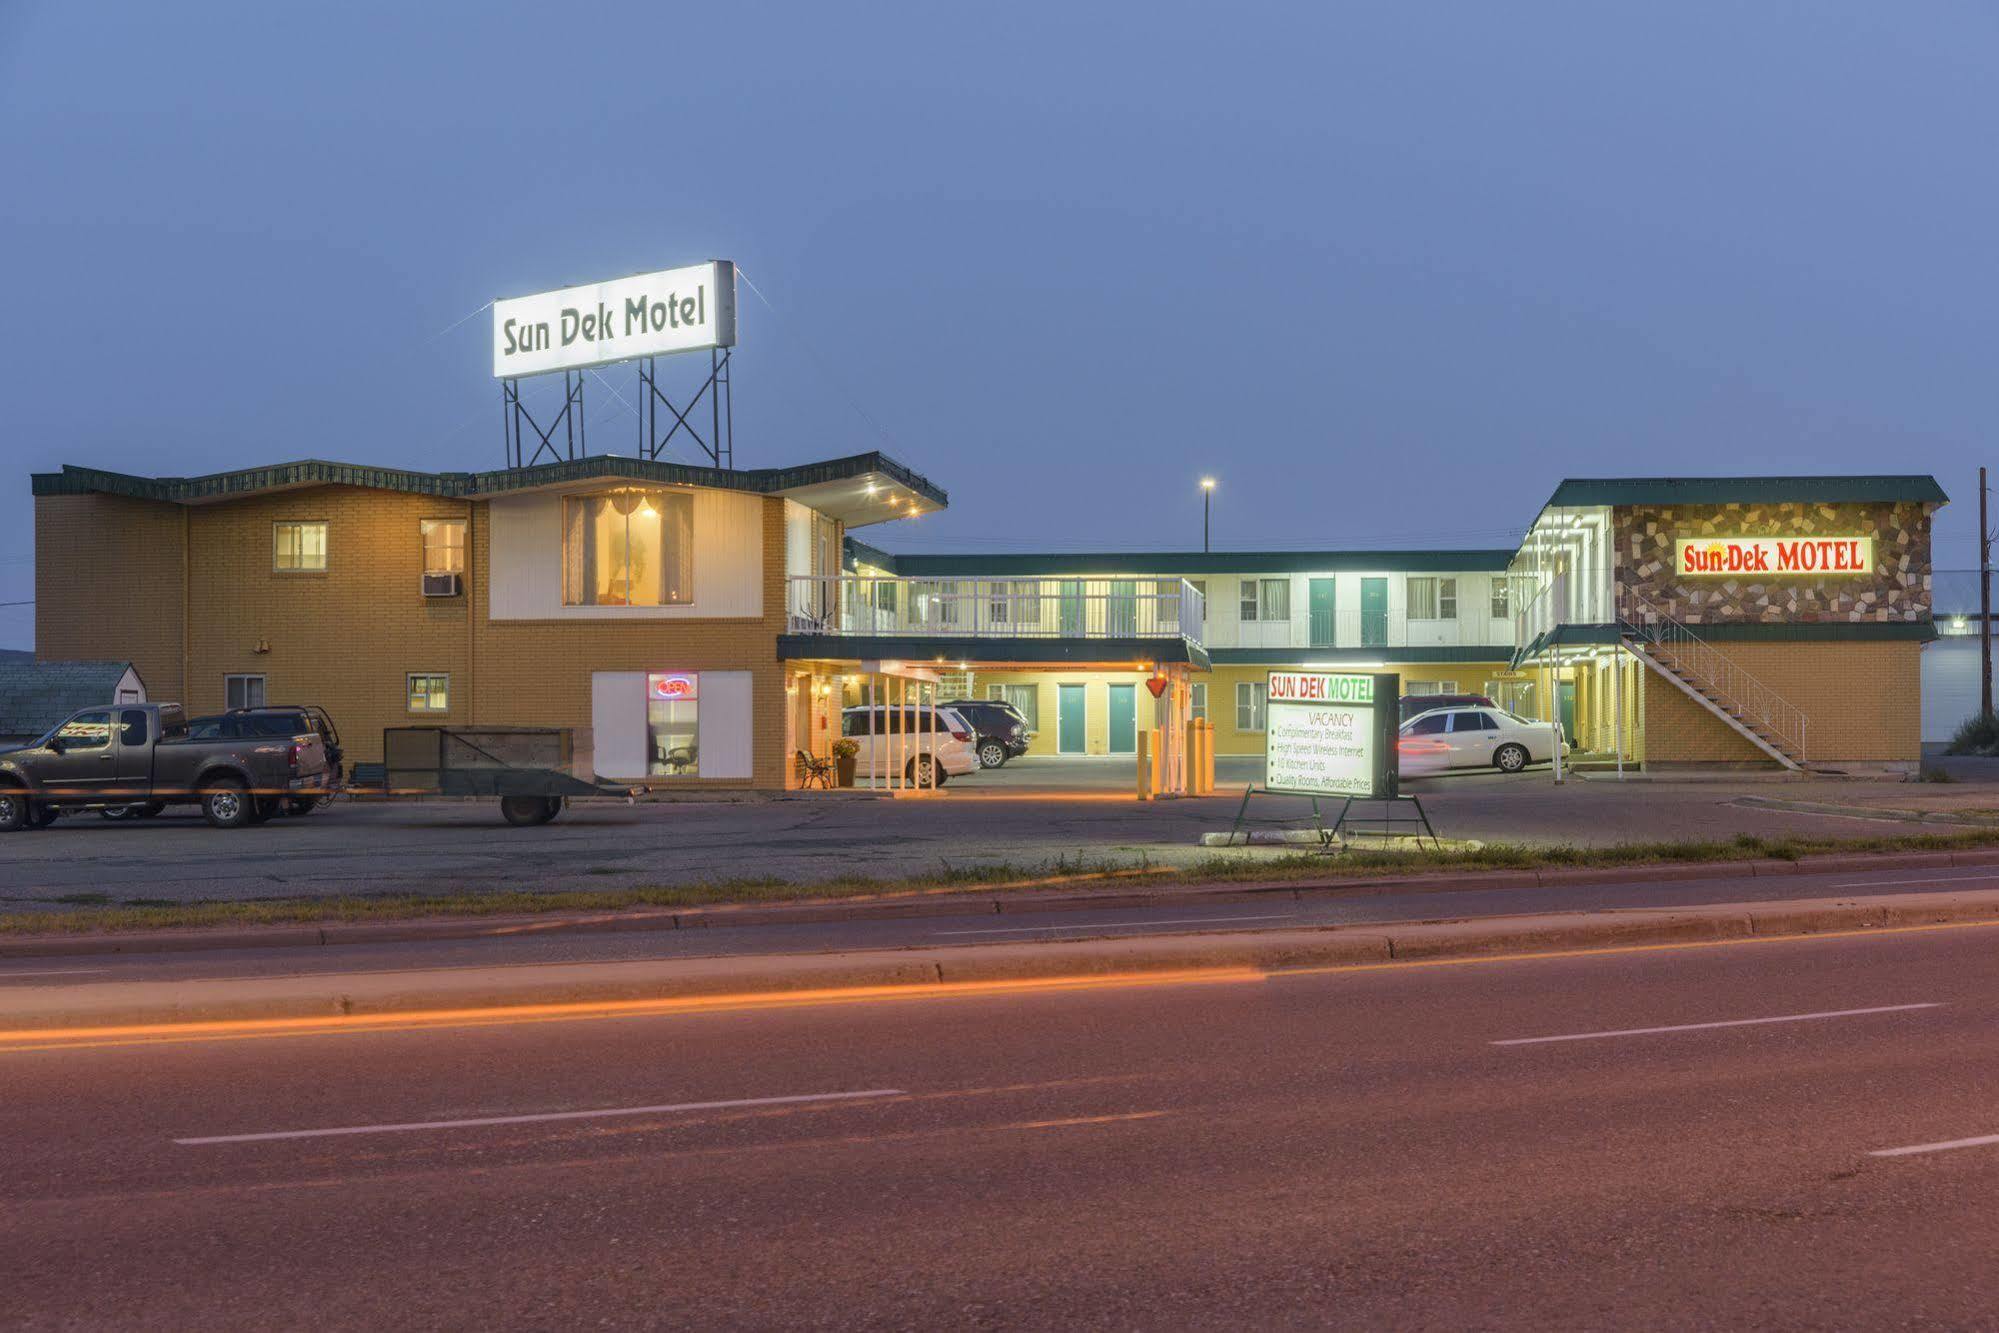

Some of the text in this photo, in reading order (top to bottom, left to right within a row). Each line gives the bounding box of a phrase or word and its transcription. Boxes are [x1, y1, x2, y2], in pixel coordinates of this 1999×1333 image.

[504, 285, 704, 356] Sun Dek Motel
[1684, 541, 1864, 572] Sun-Dek MOTEL
[1271, 676, 1374, 700] SUN DEK MOTEL
[1309, 712, 1354, 727] VACANCY
[1325, 729, 1353, 741] Breakfast
[1313, 744, 1338, 756] Wireless
[1339, 746, 1364, 758] Internet
[1276, 773, 1296, 788] Quality
[1321, 776, 1353, 789] Affordable
[1353, 778, 1371, 791] Prices
